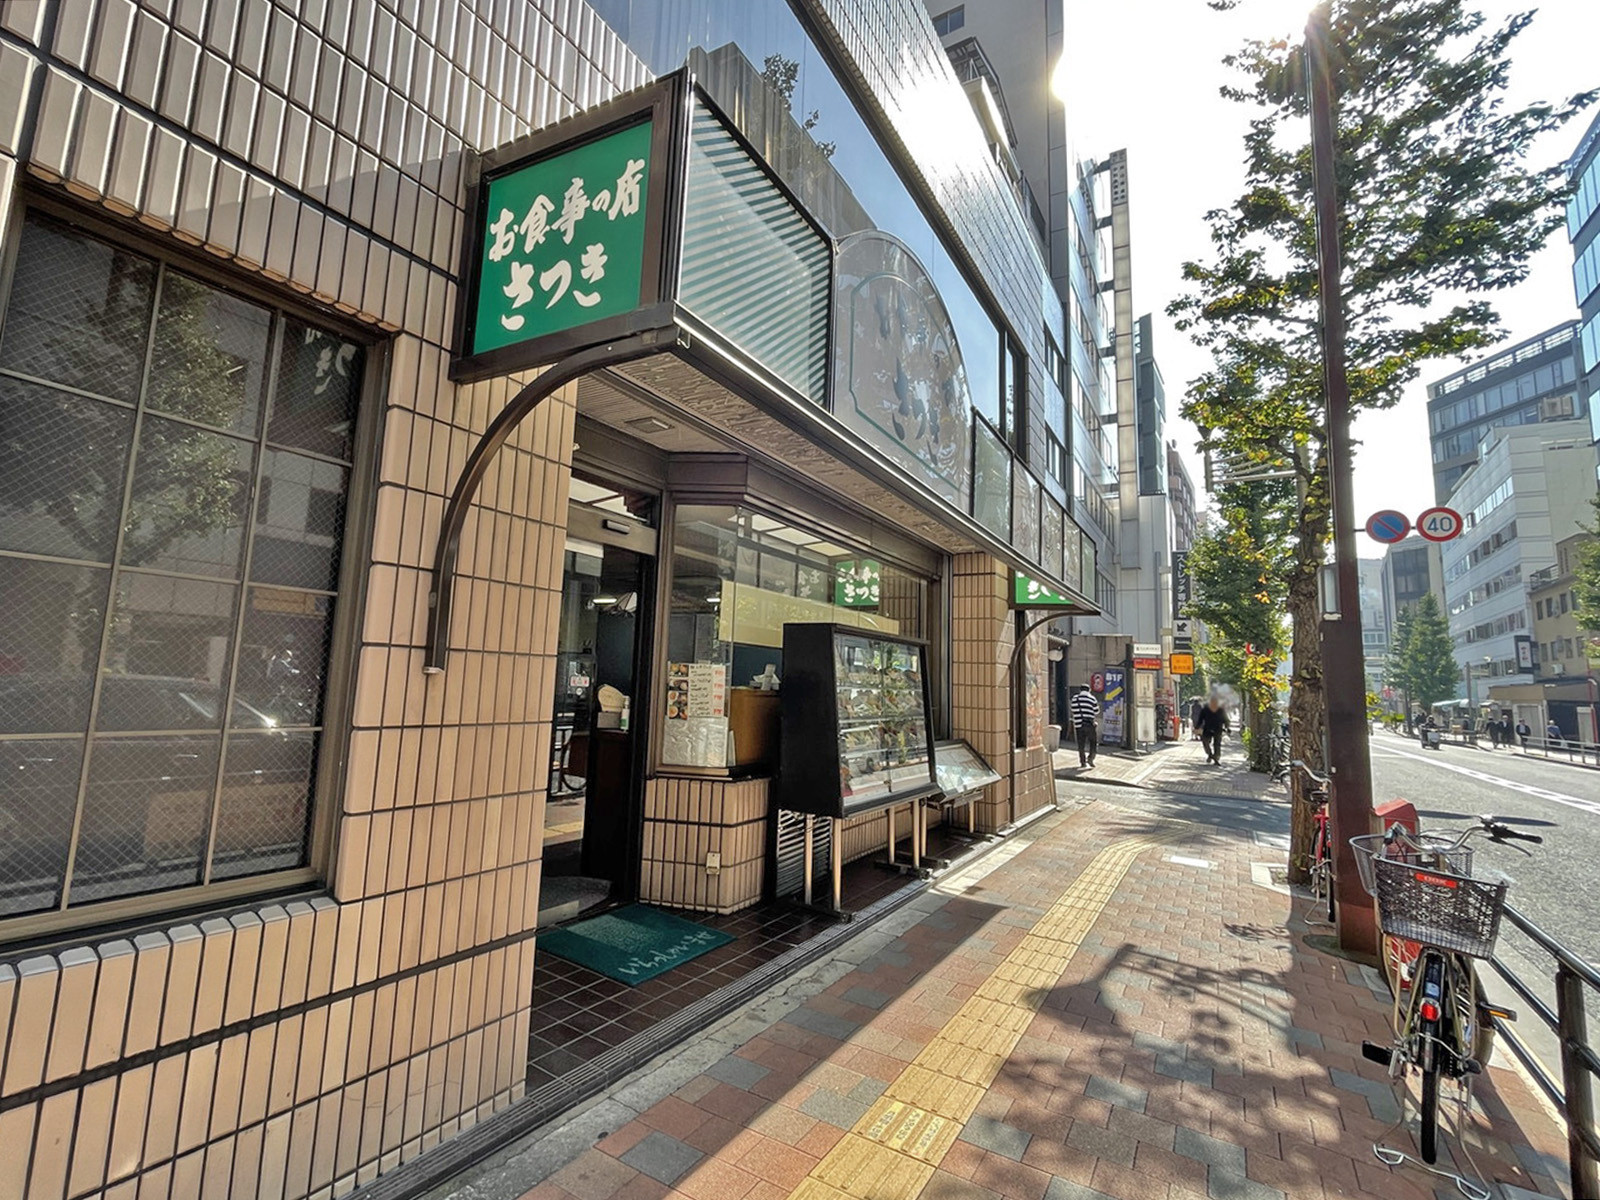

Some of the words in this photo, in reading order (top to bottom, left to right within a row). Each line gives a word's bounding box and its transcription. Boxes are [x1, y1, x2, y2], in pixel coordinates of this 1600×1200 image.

[488, 159, 646, 262] お食事の店
[501, 243, 608, 331] さつき
[1427, 516, 1453, 532] 40
